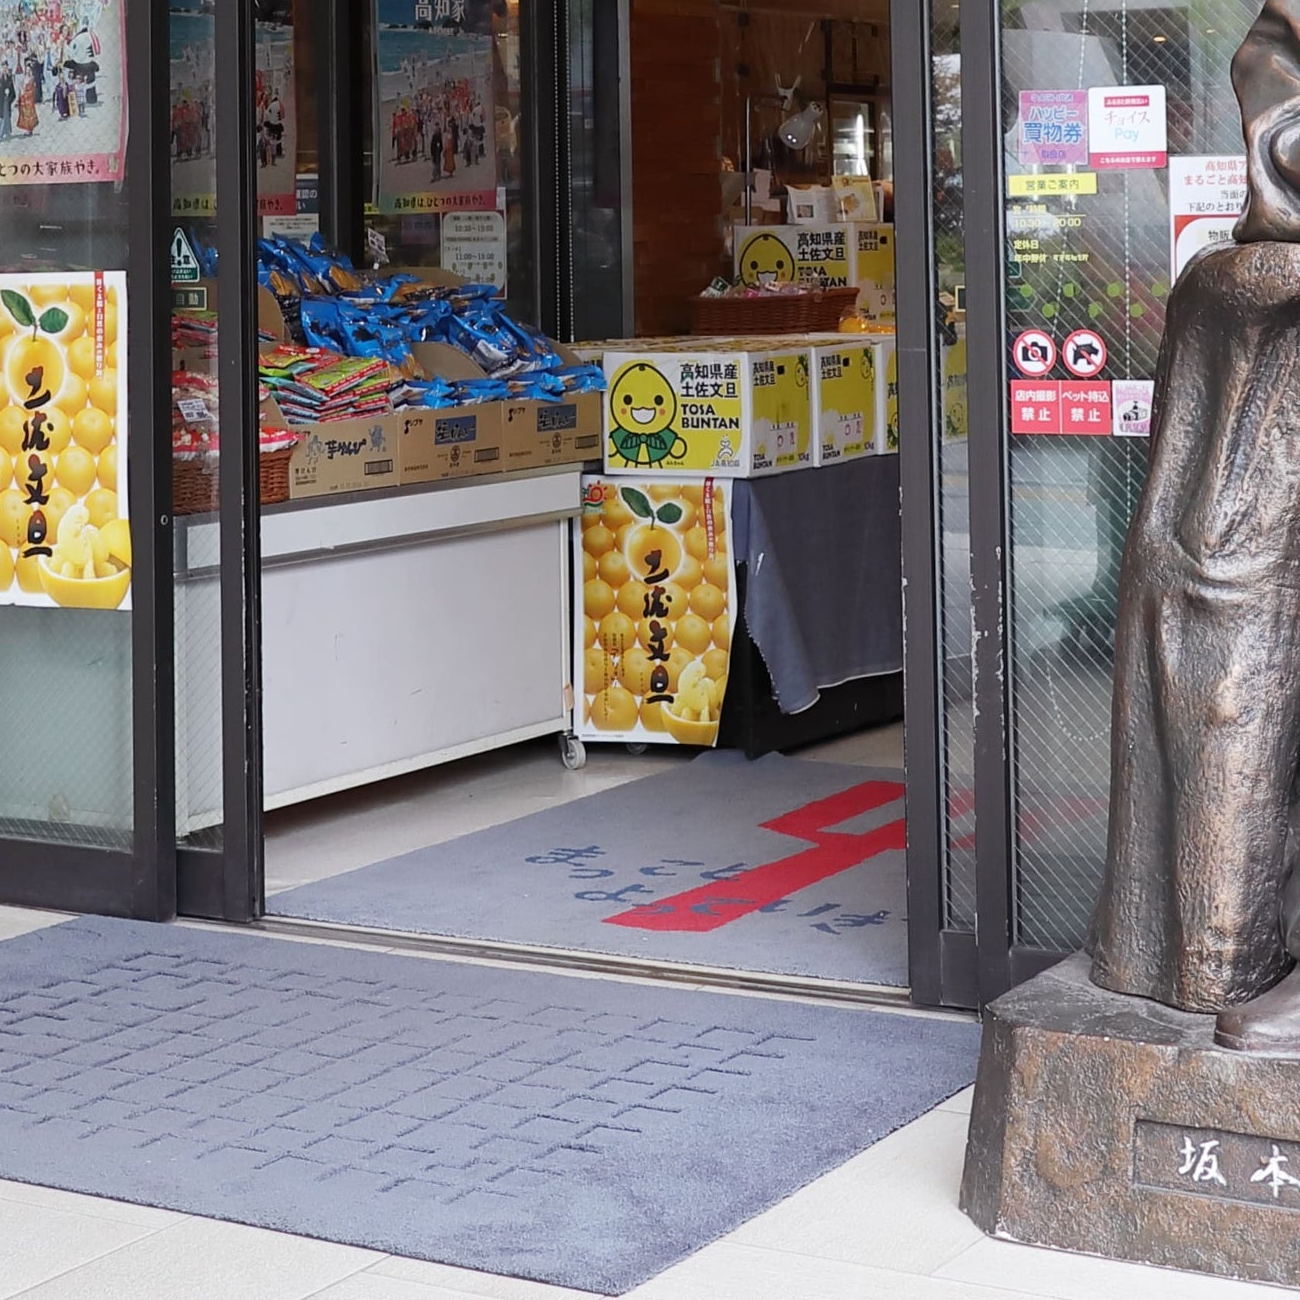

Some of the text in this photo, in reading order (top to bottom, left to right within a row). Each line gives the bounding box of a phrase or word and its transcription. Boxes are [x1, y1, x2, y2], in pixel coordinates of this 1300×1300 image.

[1030, 107, 1078, 121] ハッピー
[1104, 111, 1151, 126] チョイス
[1023, 122, 1083, 144] 買物券
[1114, 127, 1140, 144] Pay
[1025, 179, 1079, 191] 営業ご案内
[797, 231, 846, 249] 高知県産
[1013, 239, 1039, 250] 定休日
[797, 249, 846, 262] 土佐文旦
[680, 362, 738, 383] 高知県産
[681, 382, 738, 398] 土佐文旦
[1015, 389, 1056, 402] 店内撮影
[1062, 390, 1109, 403] ペット持込
[681, 403, 716, 416] TOSA
[1021, 406, 1052, 422] 禁止
[1071, 407, 1101, 422] 禁止
[681, 417, 740, 430] BUNTAN
[573, 882, 907, 936] よっていき
